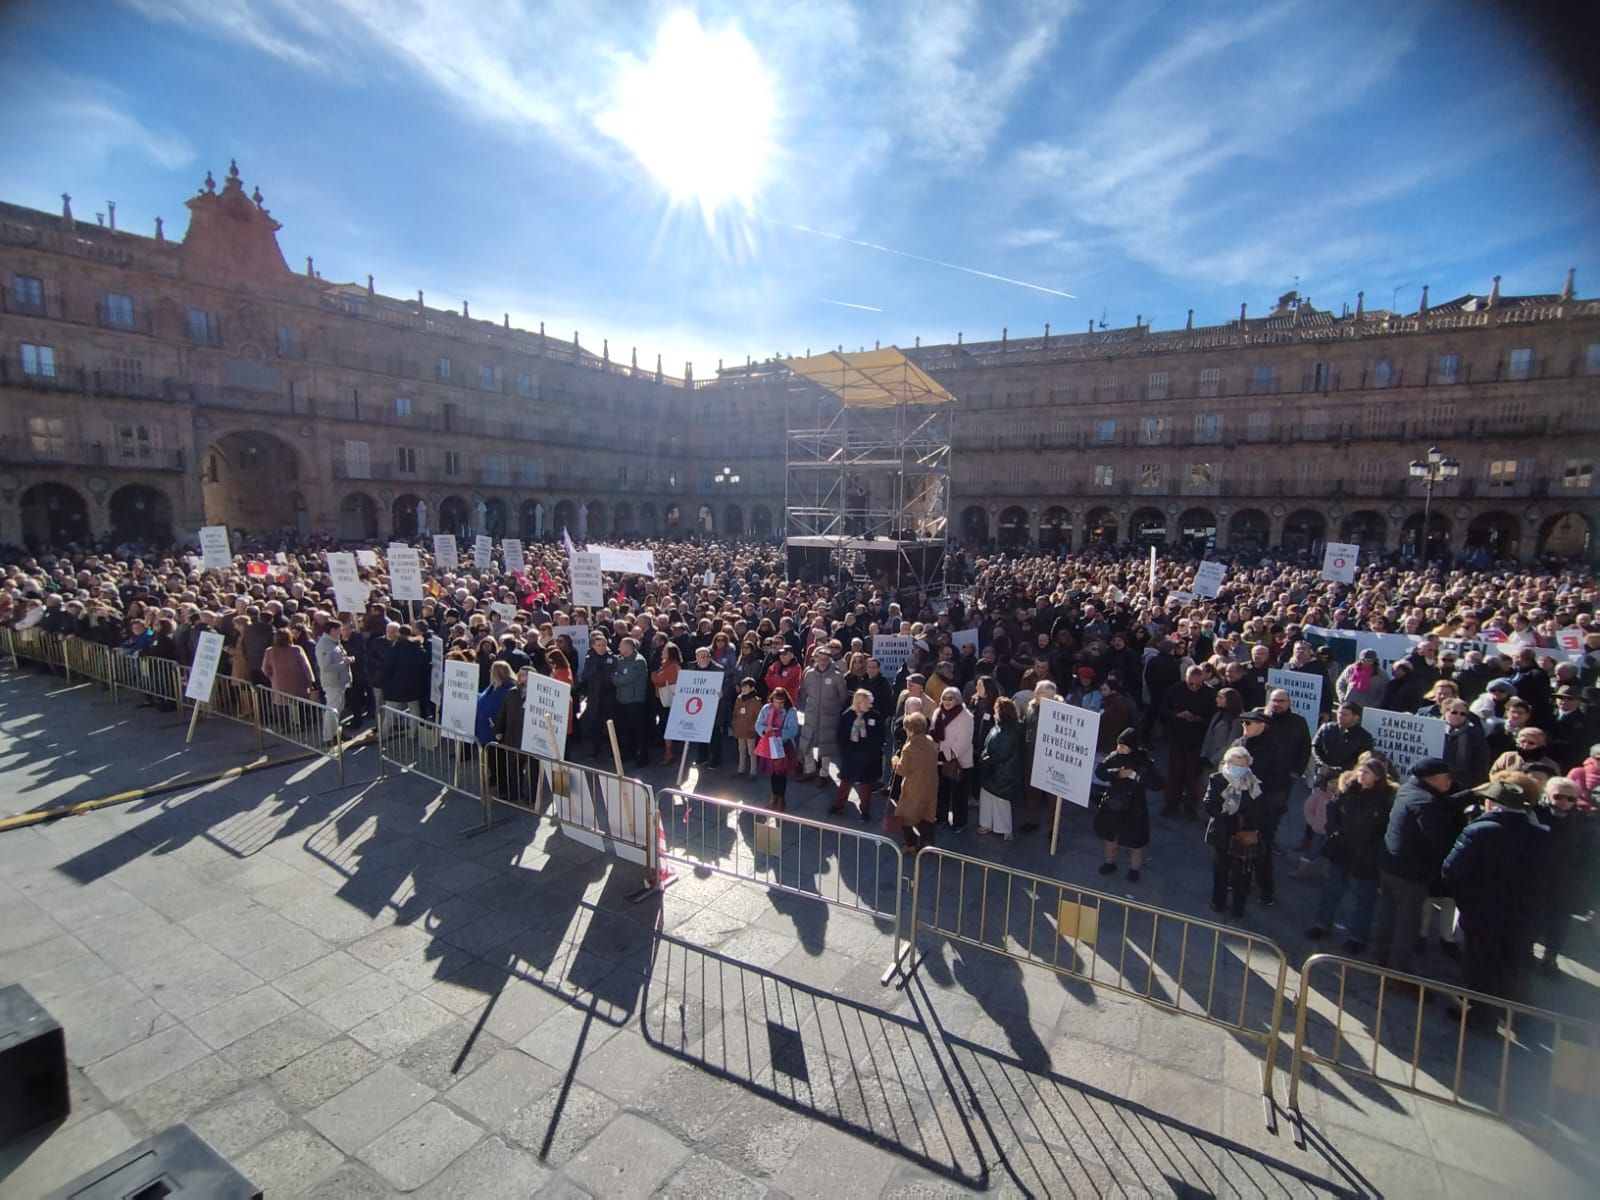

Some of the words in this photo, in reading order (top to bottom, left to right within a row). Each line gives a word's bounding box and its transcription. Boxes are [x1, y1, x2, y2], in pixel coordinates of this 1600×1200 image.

[1274, 676, 1281, 684] LA
[1284, 678, 1314, 690] DIGNIDAD
[1303, 702, 1311, 710] EN
[1052, 710, 1073, 724] RENFE
[1076, 718, 1085, 727] YA
[1382, 717, 1424, 732] SÁNCHEZ
[1044, 747, 1052, 757] LA
[1055, 750, 1082, 768] CUARTA
[1399, 754, 1411, 765] EN
